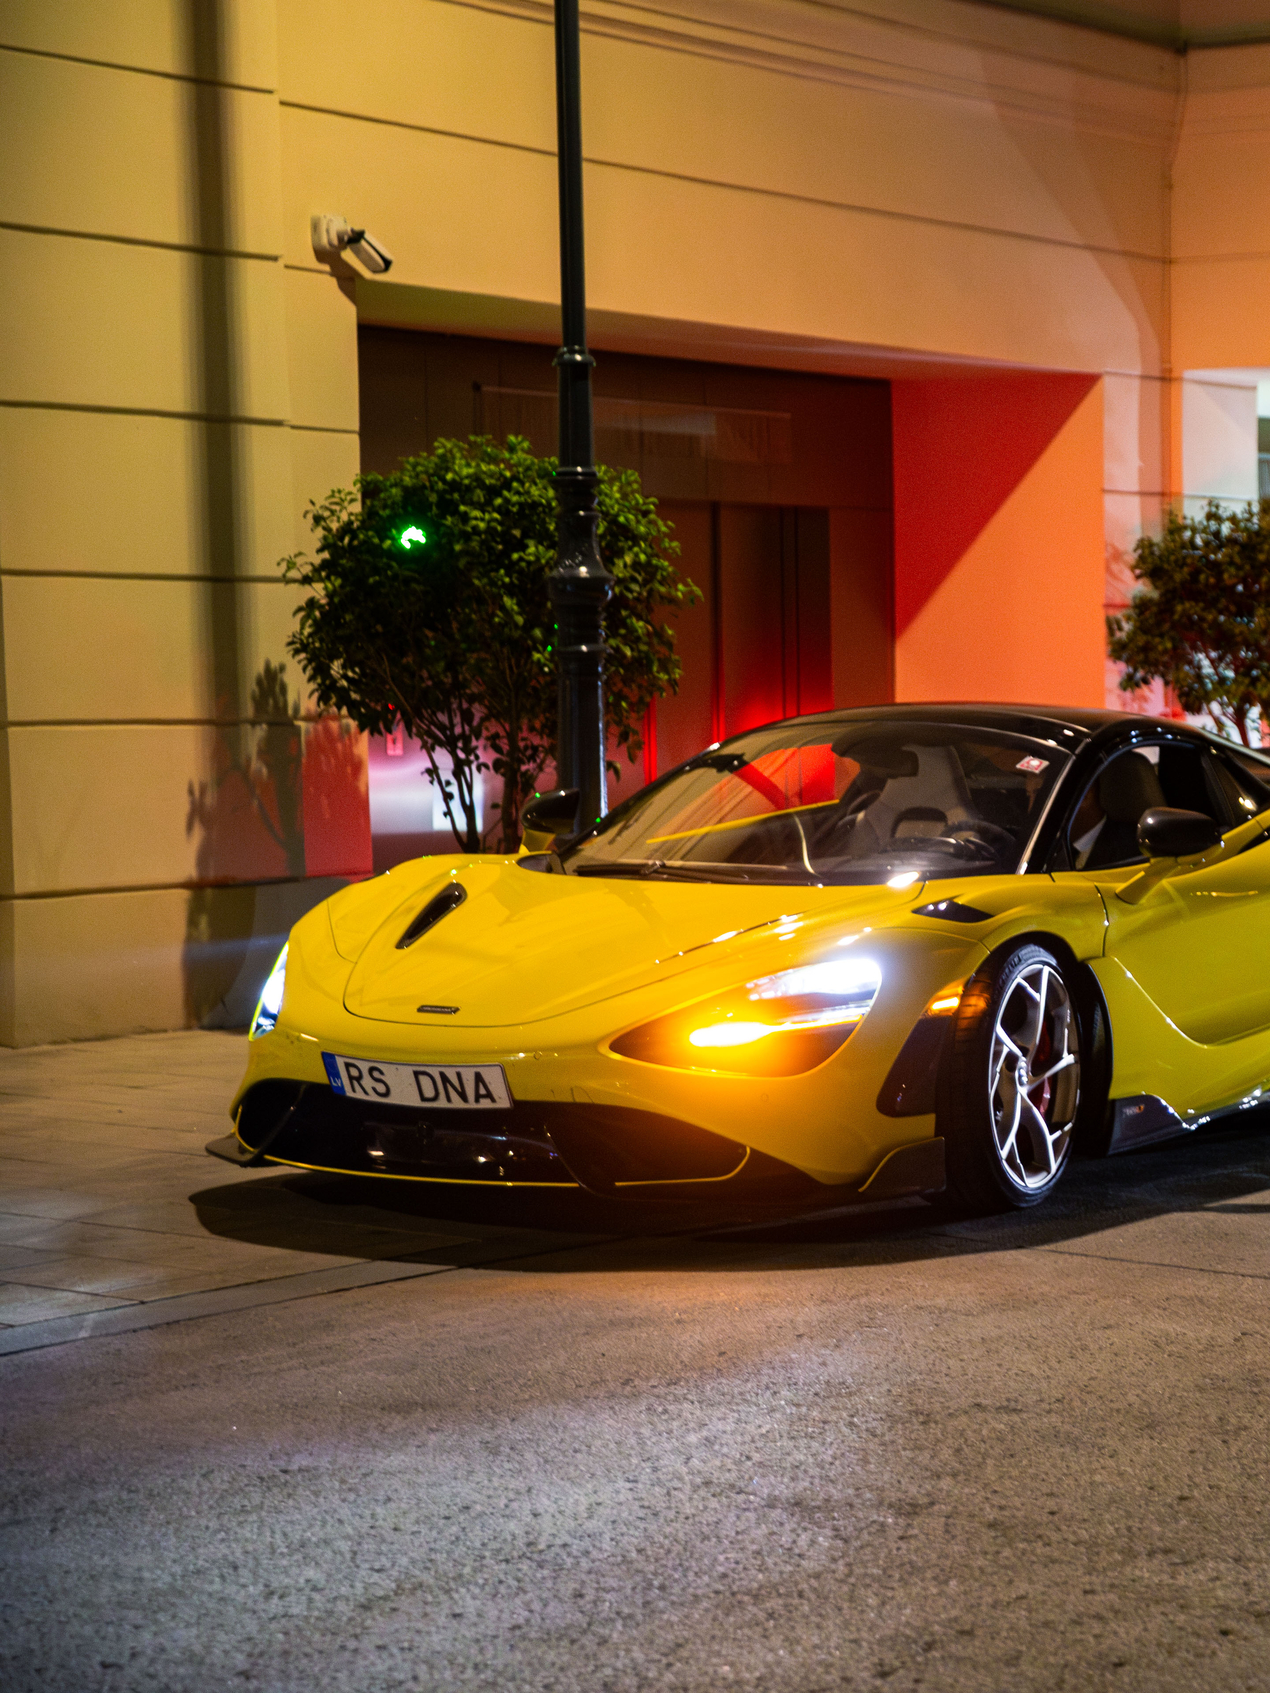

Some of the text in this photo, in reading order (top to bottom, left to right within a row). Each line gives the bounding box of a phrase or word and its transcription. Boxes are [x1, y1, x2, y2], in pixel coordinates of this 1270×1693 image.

[330, 1076, 342, 1088] LV
[343, 1061, 498, 1104] RS DNA
